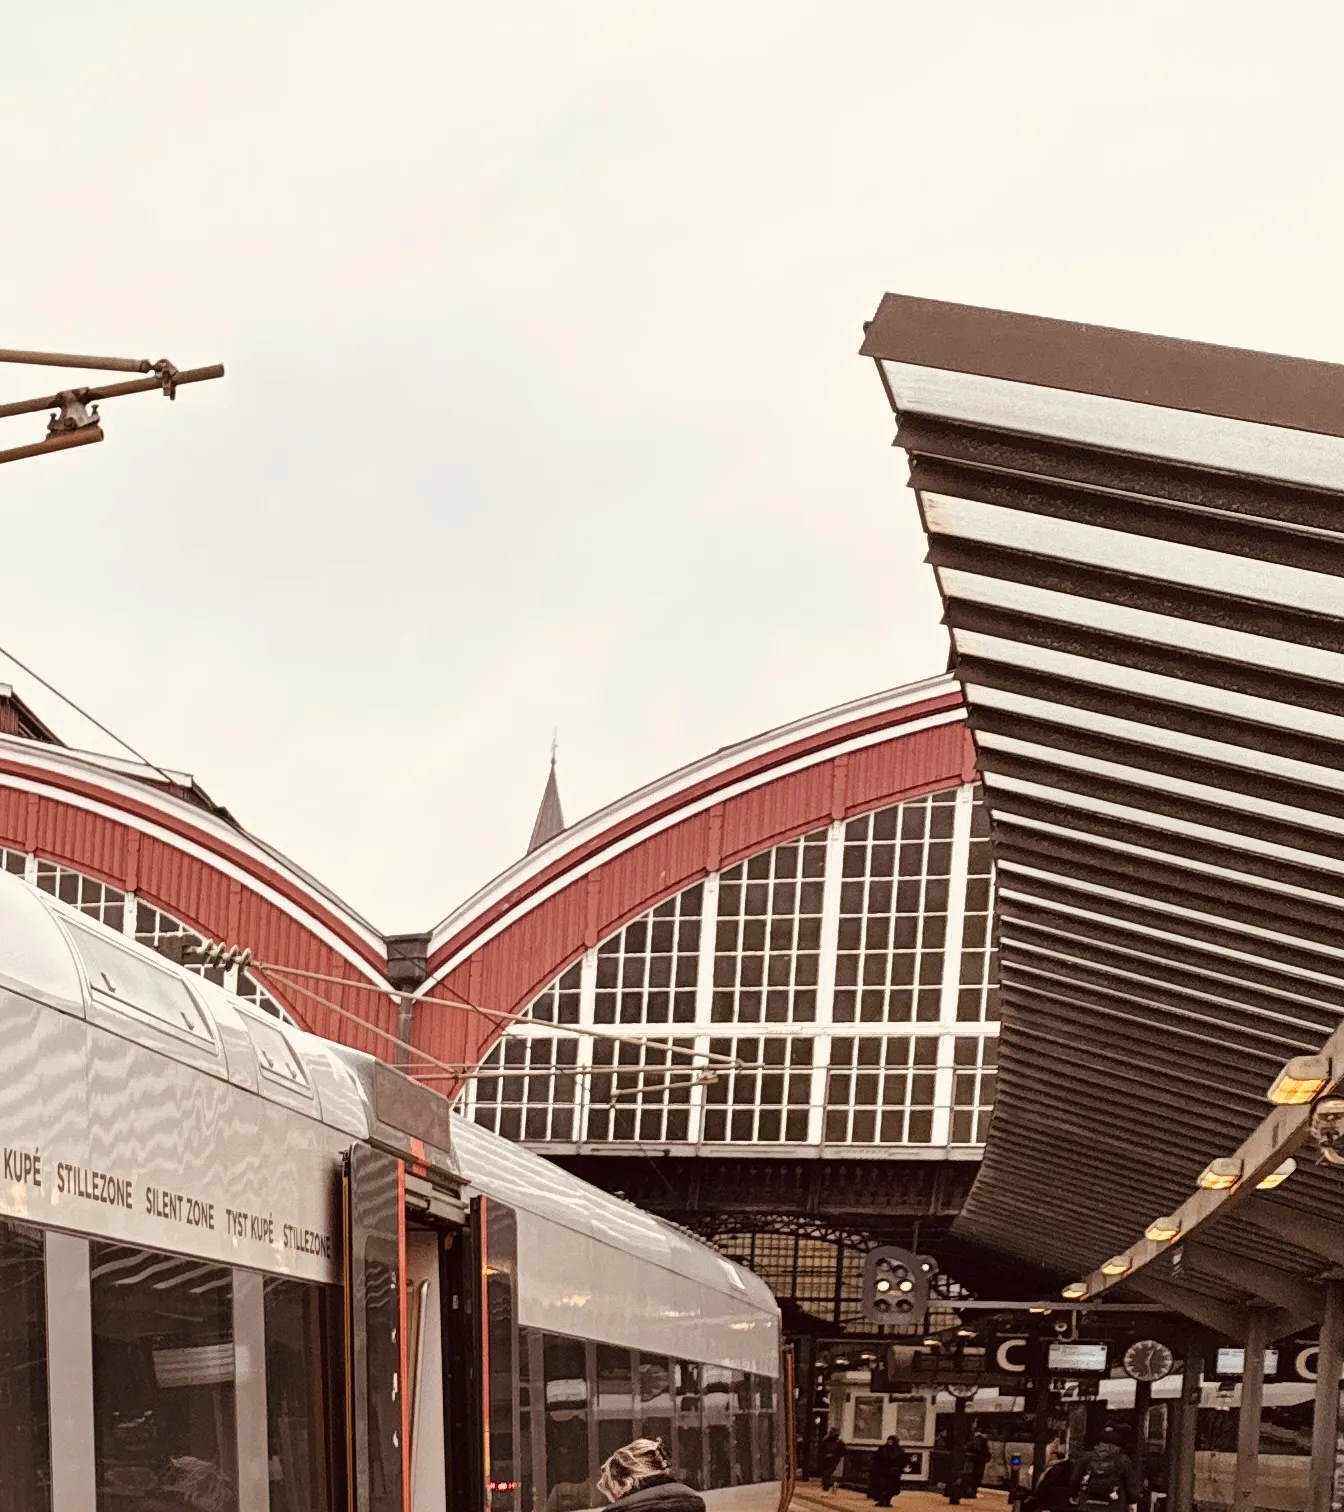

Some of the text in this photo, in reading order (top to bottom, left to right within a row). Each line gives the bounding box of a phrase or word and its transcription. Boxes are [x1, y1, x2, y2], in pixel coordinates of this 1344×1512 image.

[4, 1147, 42, 1187] KUPÉ
[57, 1162, 133, 1209] STILLEZONE
[145, 1187, 184, 1220] SILENT
[186, 1198, 215, 1230] ZONE
[225, 1209, 249, 1239] TYST
[251, 1212, 274, 1244] KUPÉ
[283, 1223, 332, 1259] STILLEZONE
[996, 1339, 1027, 1372] C
